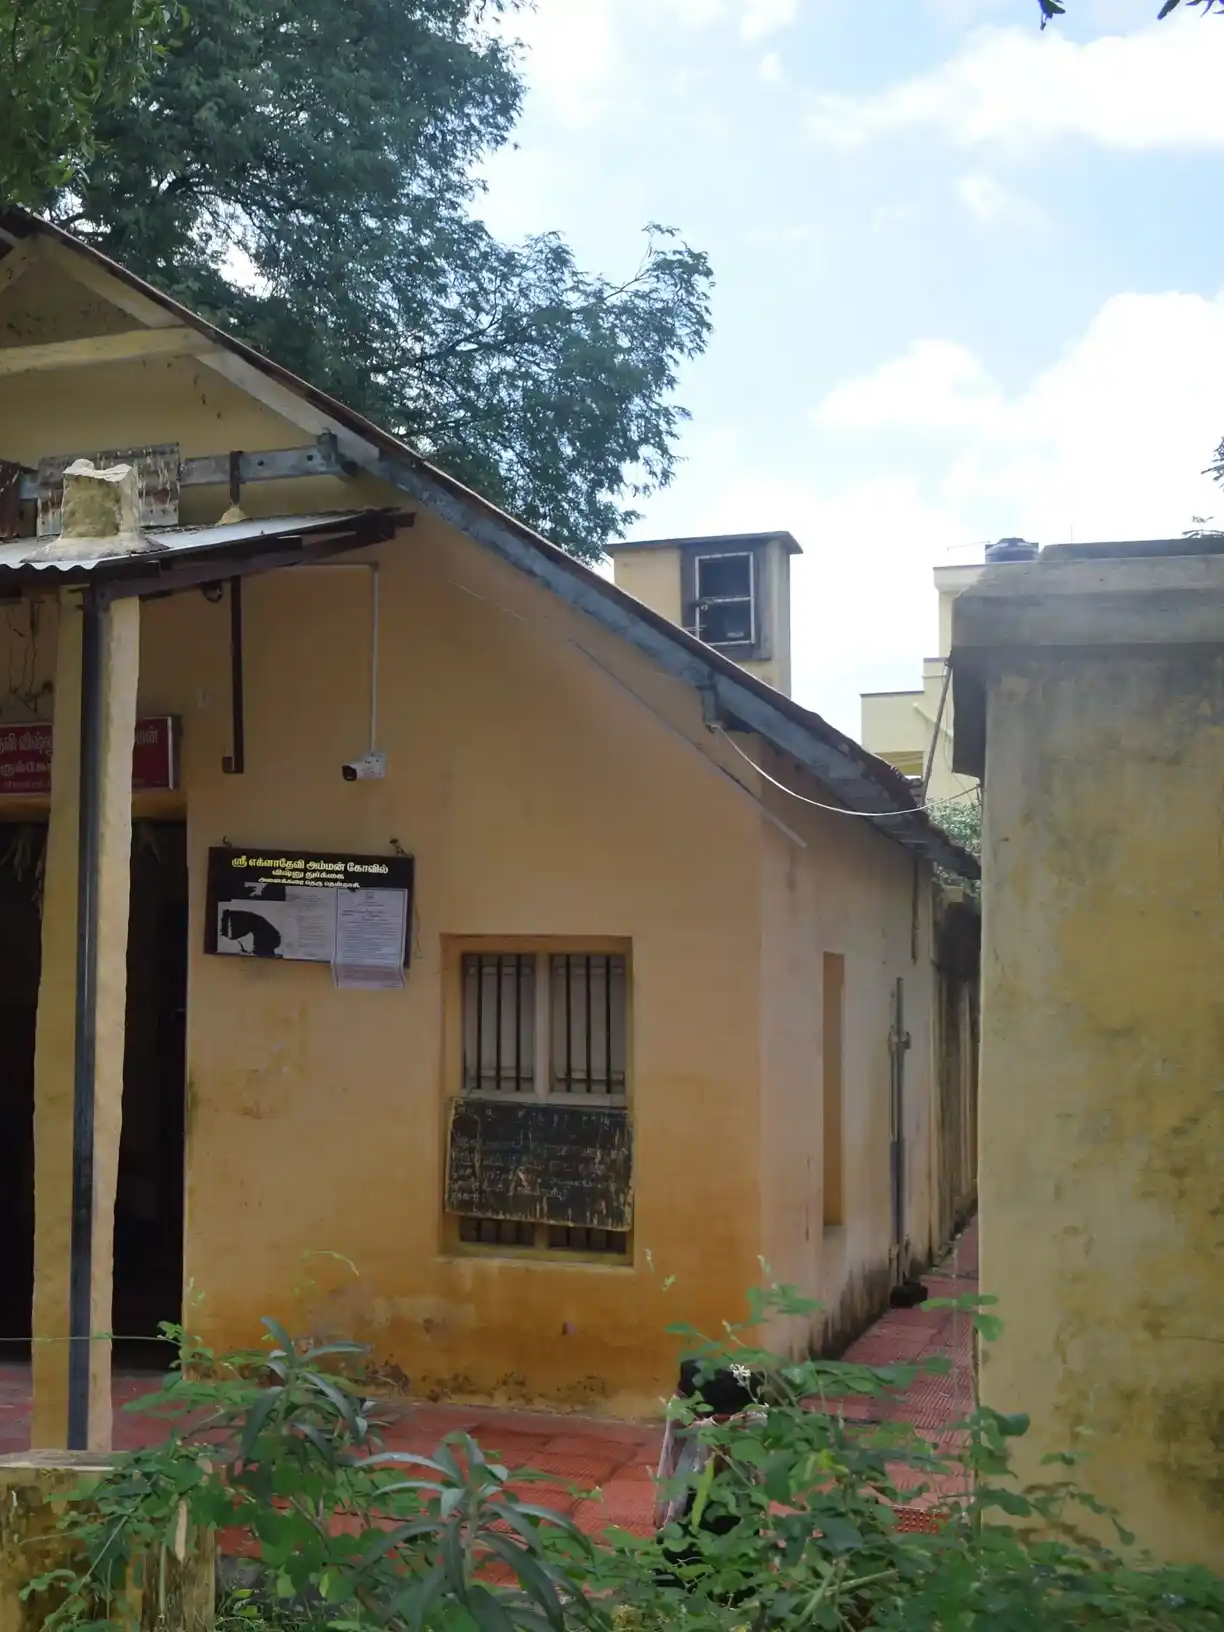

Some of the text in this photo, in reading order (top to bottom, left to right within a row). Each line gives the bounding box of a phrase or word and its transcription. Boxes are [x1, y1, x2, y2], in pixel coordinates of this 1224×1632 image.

[231, 855, 247, 868] ஸ்ரீ
[306, 859, 346, 872] அம்மன்
[347, 861, 389, 874] கோவில்
